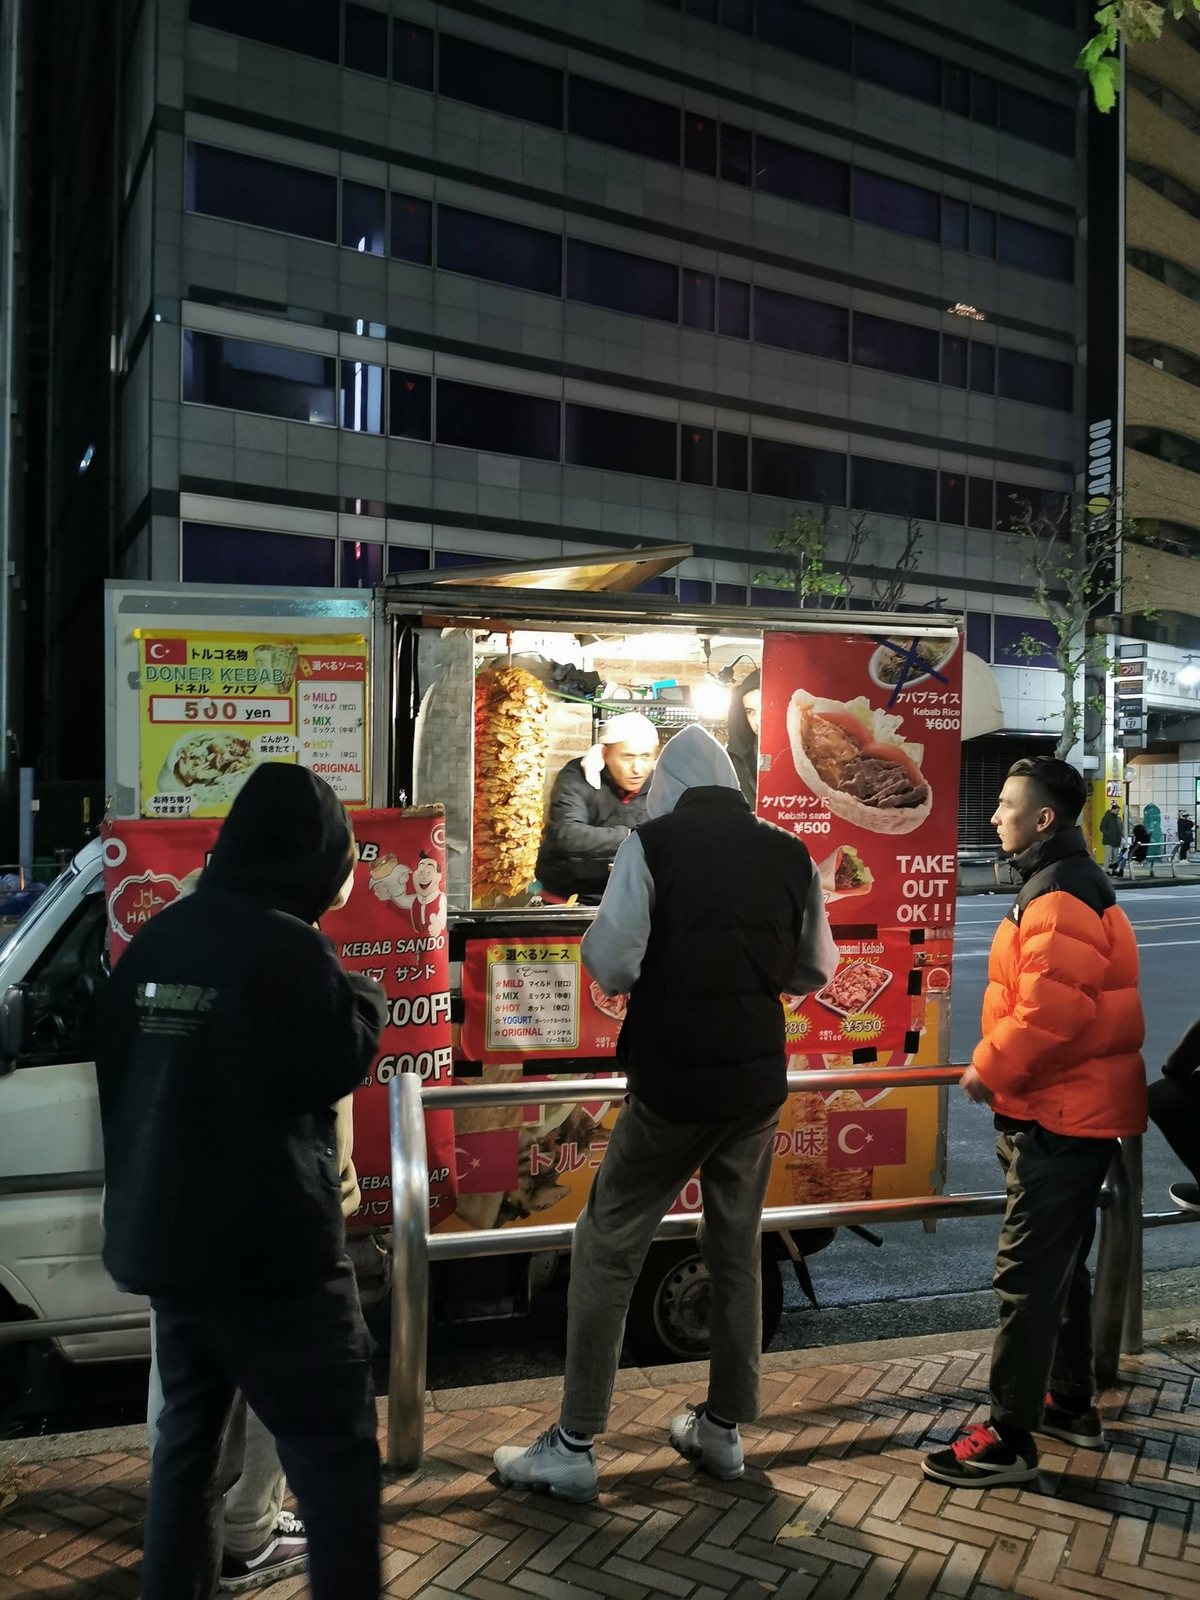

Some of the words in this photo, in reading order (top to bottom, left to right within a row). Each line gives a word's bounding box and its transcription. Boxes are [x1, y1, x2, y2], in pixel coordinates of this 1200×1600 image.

[192, 648, 248, 661] トルコ名物
[146, 666, 214, 683] DONER
[219, 667, 285, 684] KEBAB
[175, 684, 210, 694] ドネル
[222, 684, 258, 694] ケバブ
[312, 692, 337, 702] MILD
[896, 692, 961, 704] ケバブライス
[245, 709, 271, 720] yen
[913, 707, 941, 716] Kebab
[942, 708, 960, 716] Rice
[312, 717, 331, 726] MIX
[925, 718, 960, 730] ¥600
[312, 726, 336, 734] ミックス
[260, 735, 290, 743] こんがり
[312, 740, 334, 749] HOT
[312, 763, 361, 773] ORIGINAL
[153, 796, 191, 804] お持ち帰り
[761, 795, 831, 808] ケバブサンド
[153, 806, 190, 814] できます！
[778, 811, 807, 820] Kebab
[808, 812, 831, 820] sand
[793, 822, 831, 834] ¥500
[896, 855, 955, 873] TAKE
[902, 880, 949, 898] OUT
[342, 941, 392, 957] KEBAB
[396, 936, 445, 953] SANDO
[862, 942, 884, 954] Kebab
[506, 949, 570, 960] 選べるソース
[396, 964, 436, 981] サンド
[503, 980, 524, 988] MILD
[503, 992, 519, 1000] MIX
[502, 1004, 520, 1012] HOT
[503, 1016, 532, 1025] YOGURT
[844, 1020, 882, 1032] ¥550
[502, 1028, 543, 1037] ORIGINAL
[377, 1046, 451, 1084] 600円
